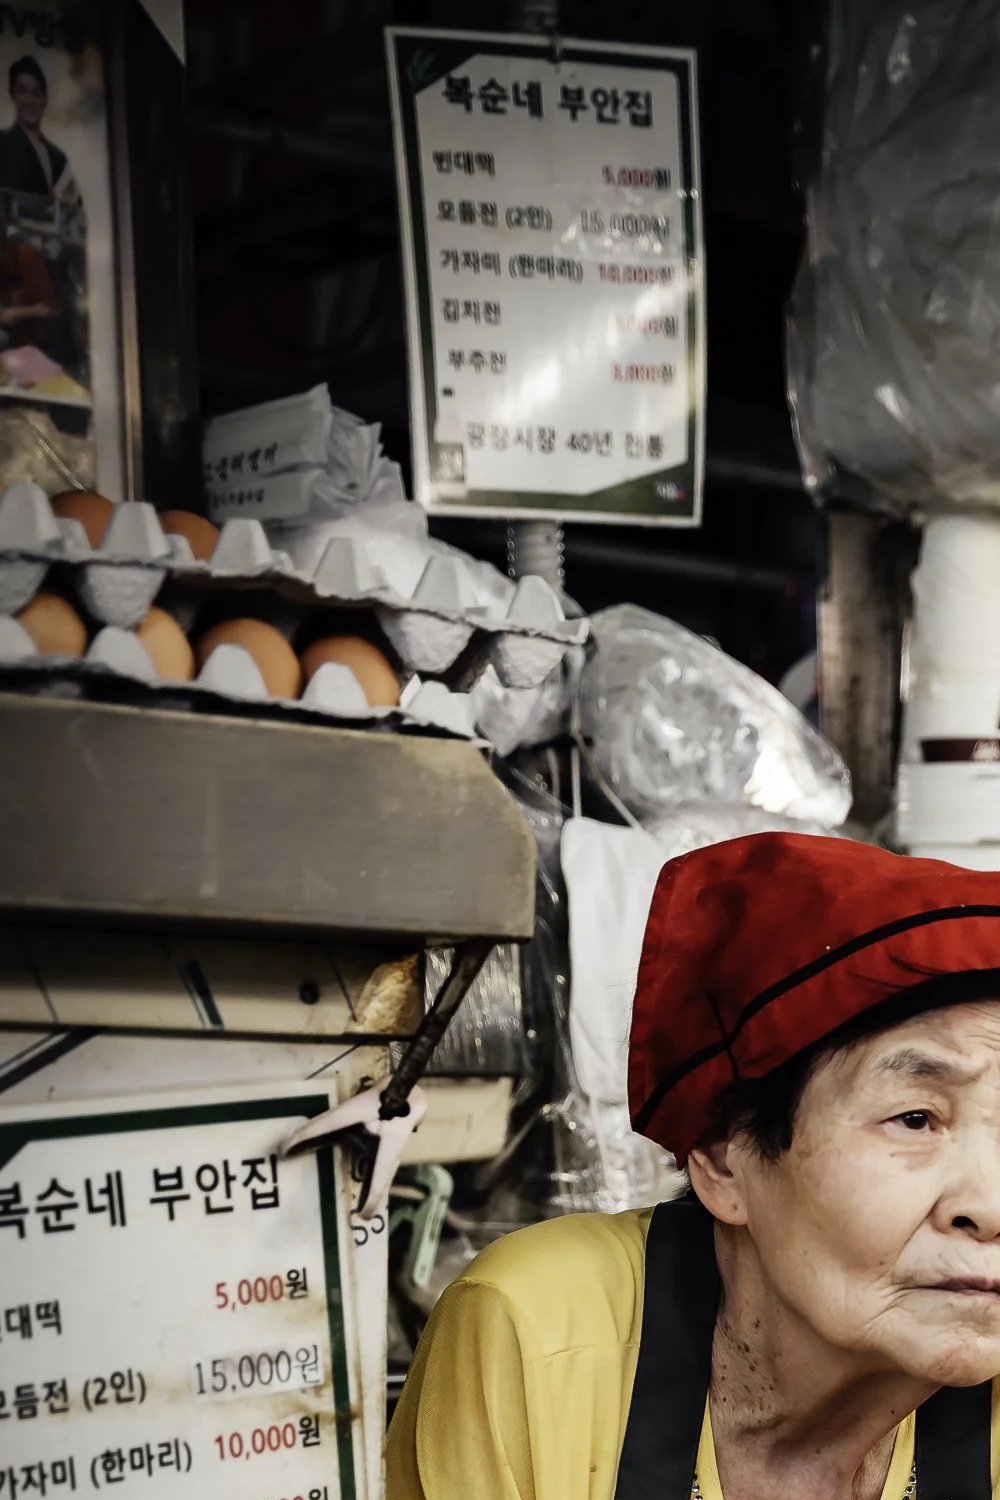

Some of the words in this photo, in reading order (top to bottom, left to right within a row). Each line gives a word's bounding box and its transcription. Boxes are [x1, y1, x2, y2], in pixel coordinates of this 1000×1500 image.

[442, 74, 544, 119] 복순네
[557, 84, 653, 128] 부안집
[149, 1153, 280, 1222] 부안집
[215, 1266, 309, 1312] 5,000원
[0, 1299, 62, 1341] 대떡
[83, 1367, 148, 1412] (2인)
[214, 1413, 321, 1462] 10,000원
[90, 1438, 193, 1489] (한마리)
